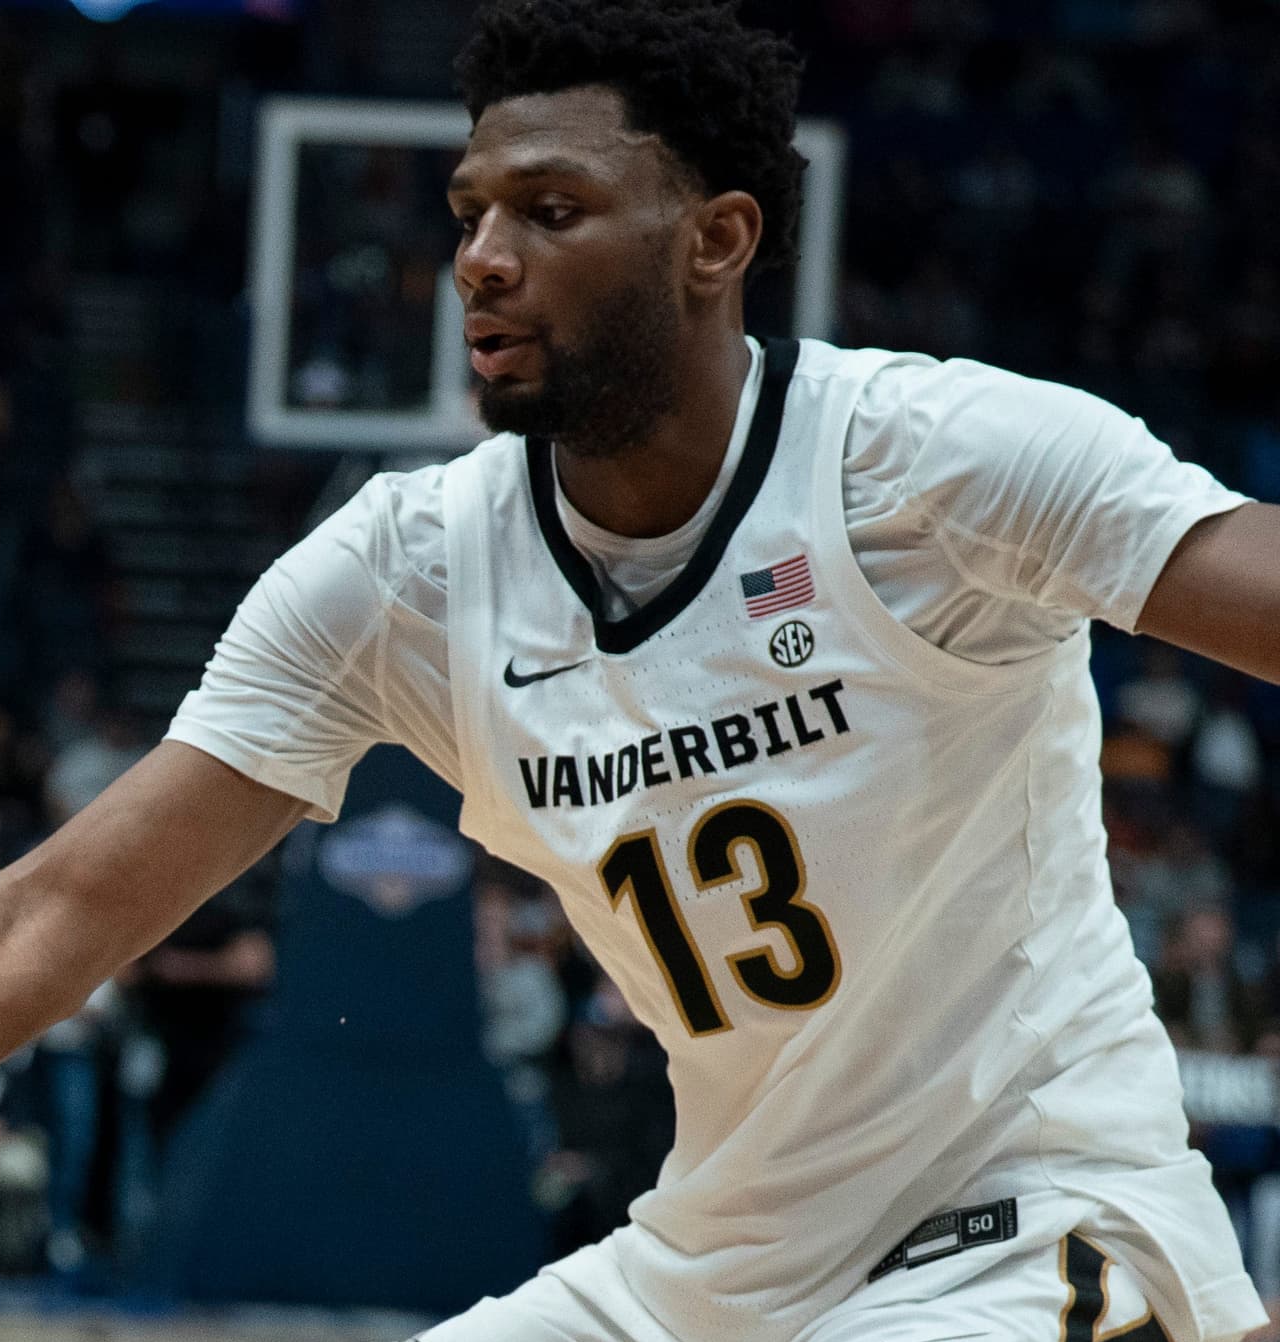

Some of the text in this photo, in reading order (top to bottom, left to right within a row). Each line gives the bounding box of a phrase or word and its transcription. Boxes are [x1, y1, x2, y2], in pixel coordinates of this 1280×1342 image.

[770, 621, 813, 667] SEC
[518, 679, 851, 808] VANDERBILT
[595, 798, 842, 1038] 13
[968, 1214, 994, 1234] 50
